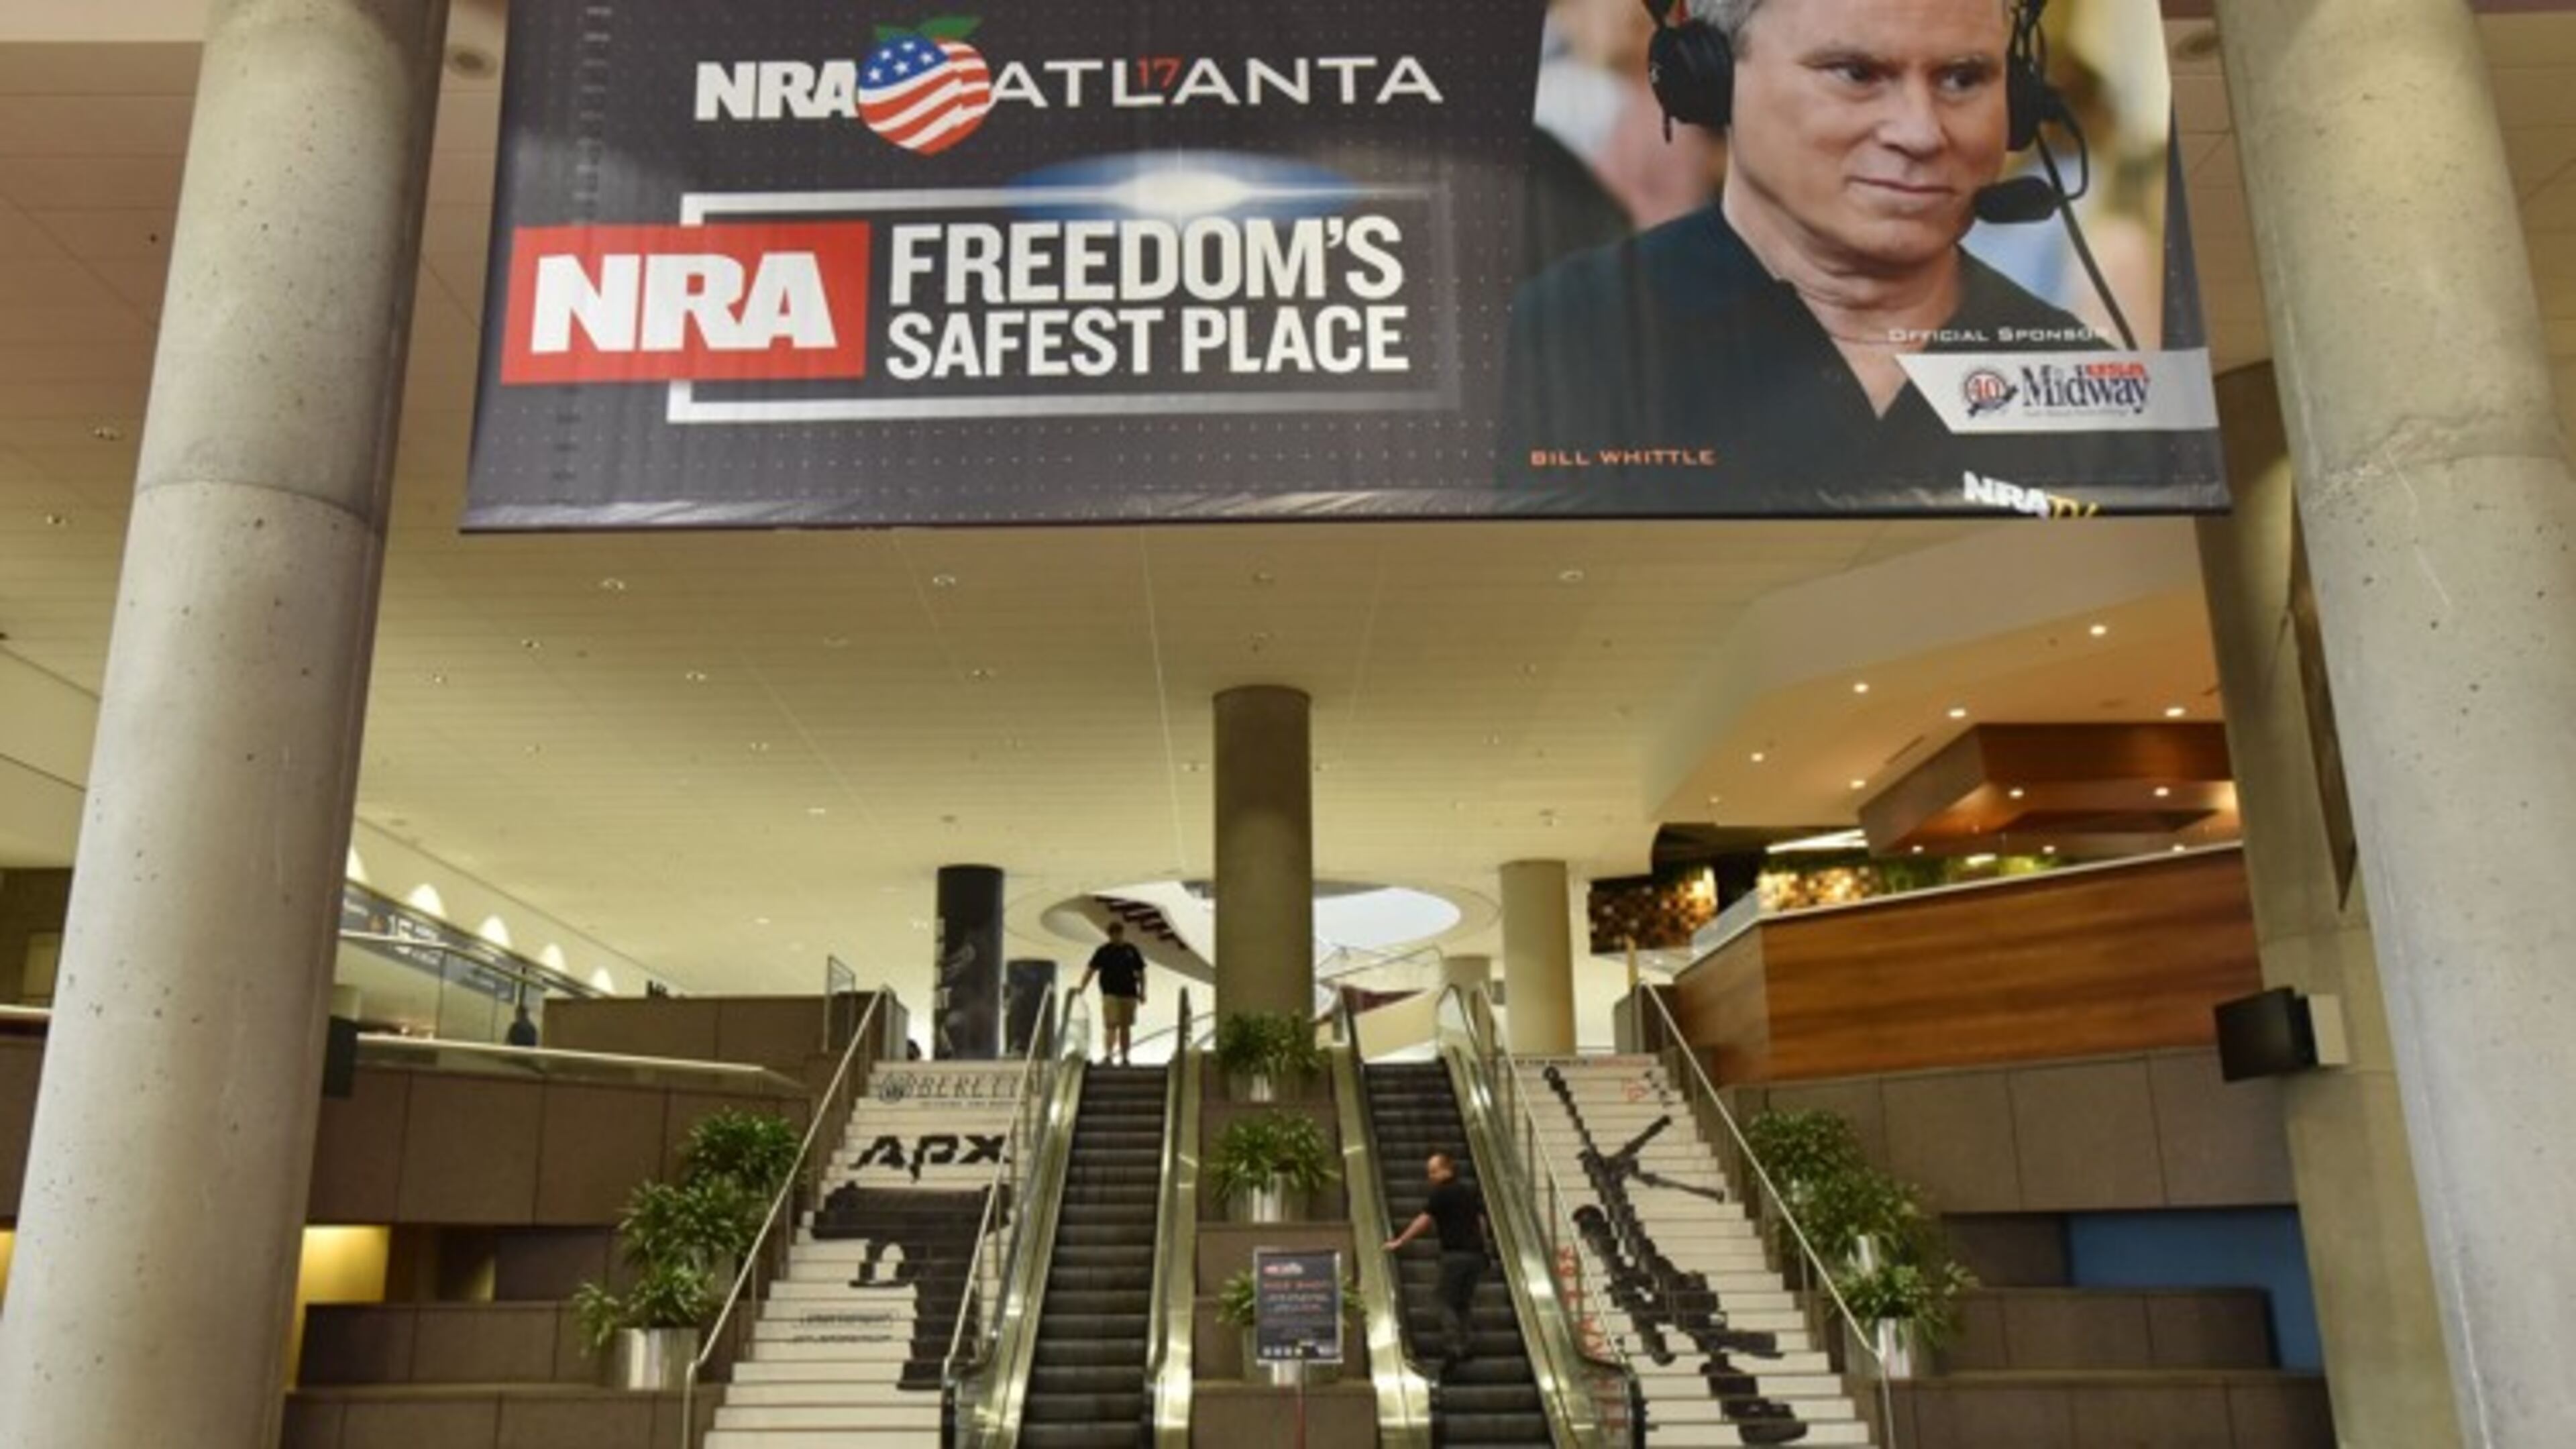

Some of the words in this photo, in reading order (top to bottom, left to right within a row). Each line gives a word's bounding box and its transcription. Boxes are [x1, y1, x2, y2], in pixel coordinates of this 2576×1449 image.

[695, 60, 859, 120] NRA
[989, 56, 1444, 109] ATLANTA
[1140, 57, 1181, 89] 17
[890, 215, 1404, 305] FREEDOM'S
[531, 252, 837, 354] NRA
[885, 307, 1164, 380] SAFEST
[1181, 305, 1410, 374] PLACE
[2021, 364, 2149, 415] Midway
[1530, 449, 1590, 466] BILL
[1598, 449, 1715, 466] WHITTLE
